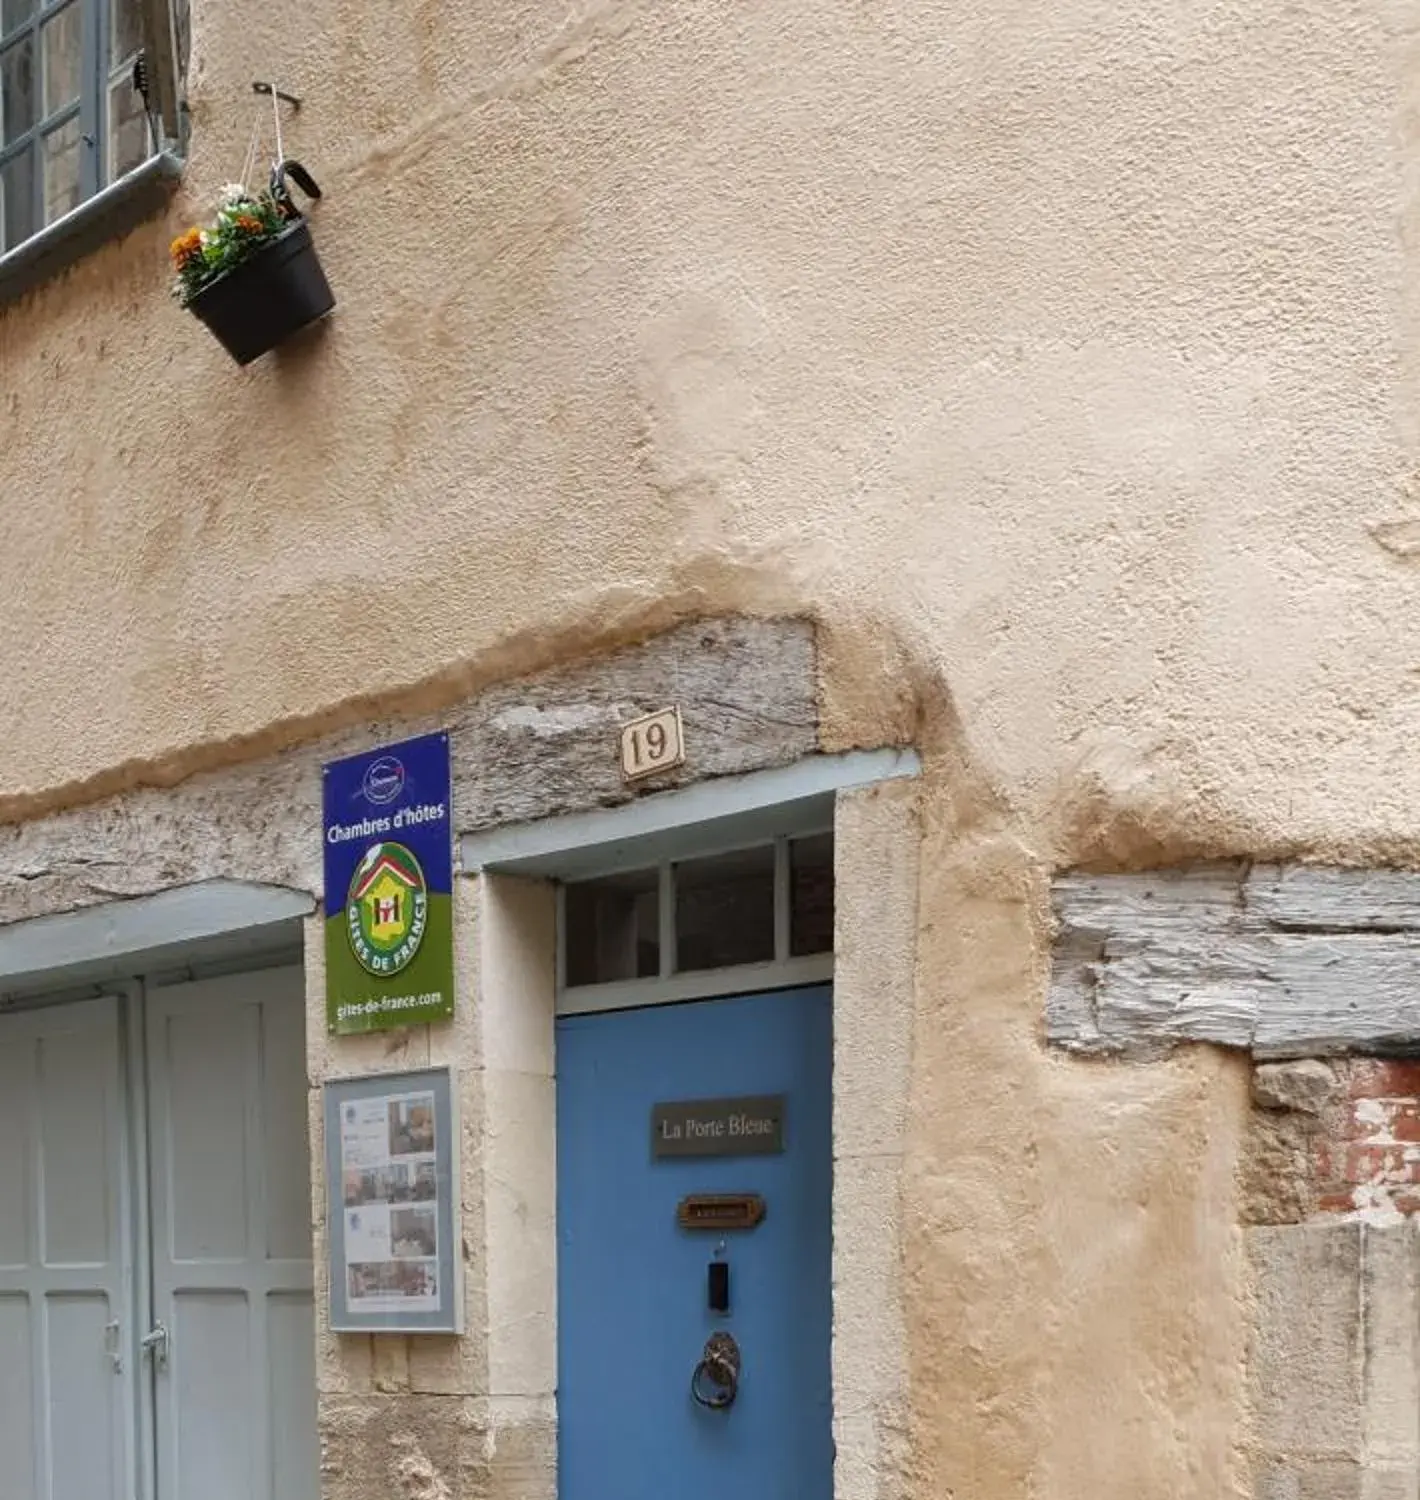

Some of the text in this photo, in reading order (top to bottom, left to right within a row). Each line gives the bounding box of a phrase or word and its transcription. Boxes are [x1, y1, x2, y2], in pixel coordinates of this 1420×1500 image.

[631, 723, 666, 765] 19
[327, 803, 445, 843] Chambres d'hôtes
[372, 955, 390, 971] DE
[393, 892, 424, 967] FRANCE
[661, 1112, 774, 1139] La Porte Bleue
